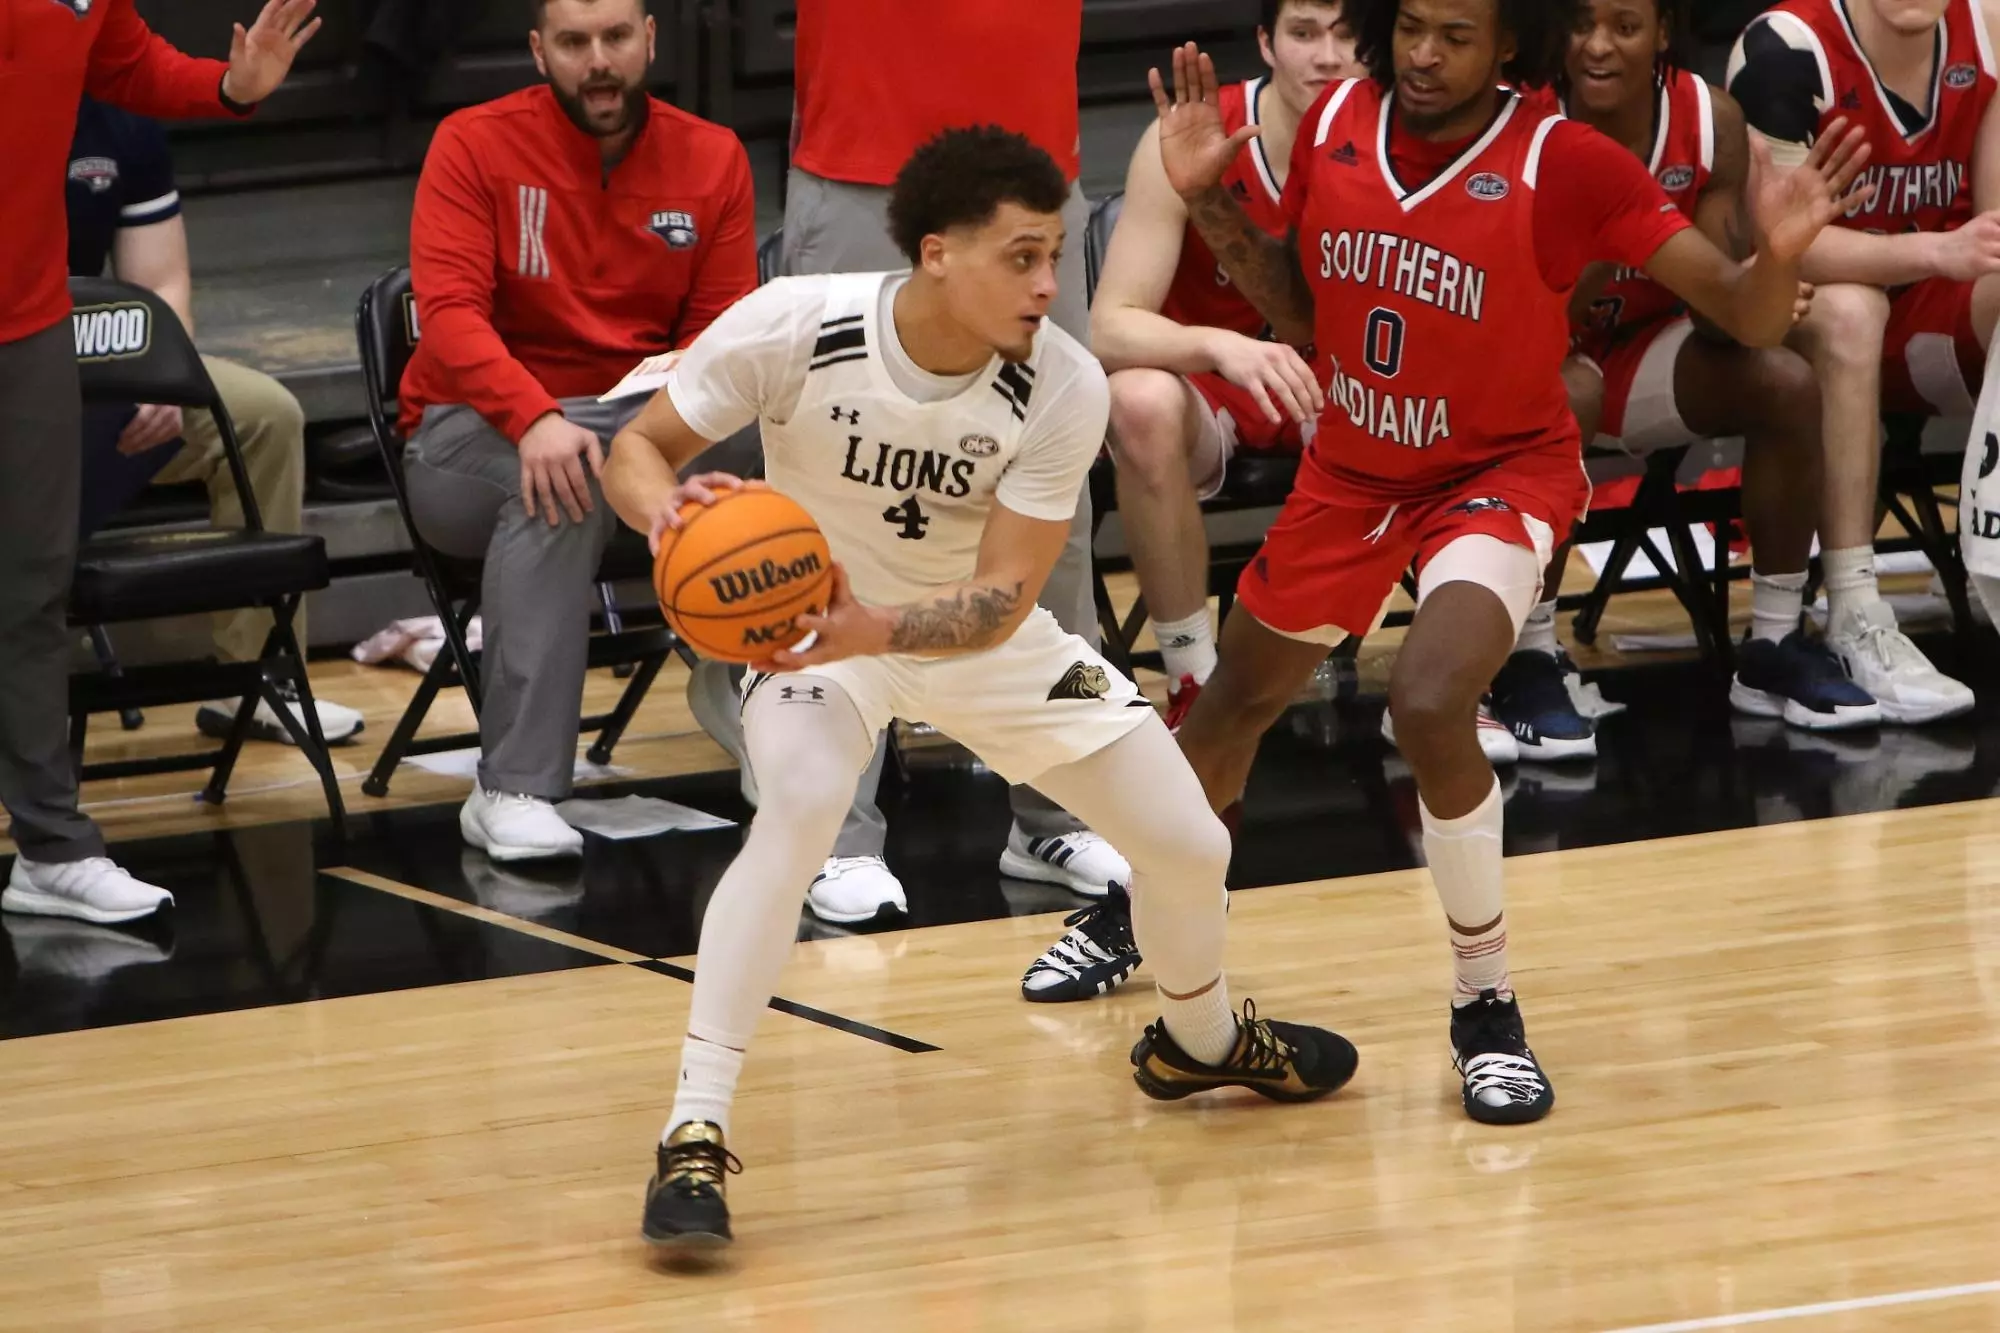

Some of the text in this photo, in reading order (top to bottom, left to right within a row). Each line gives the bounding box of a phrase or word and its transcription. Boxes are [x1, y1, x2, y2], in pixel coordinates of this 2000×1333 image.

[1319, 230, 1486, 322] SOUTHERN
[840, 435, 976, 498] LIONS
[881, 493, 930, 540] 4
[709, 552, 822, 605] Wilson
